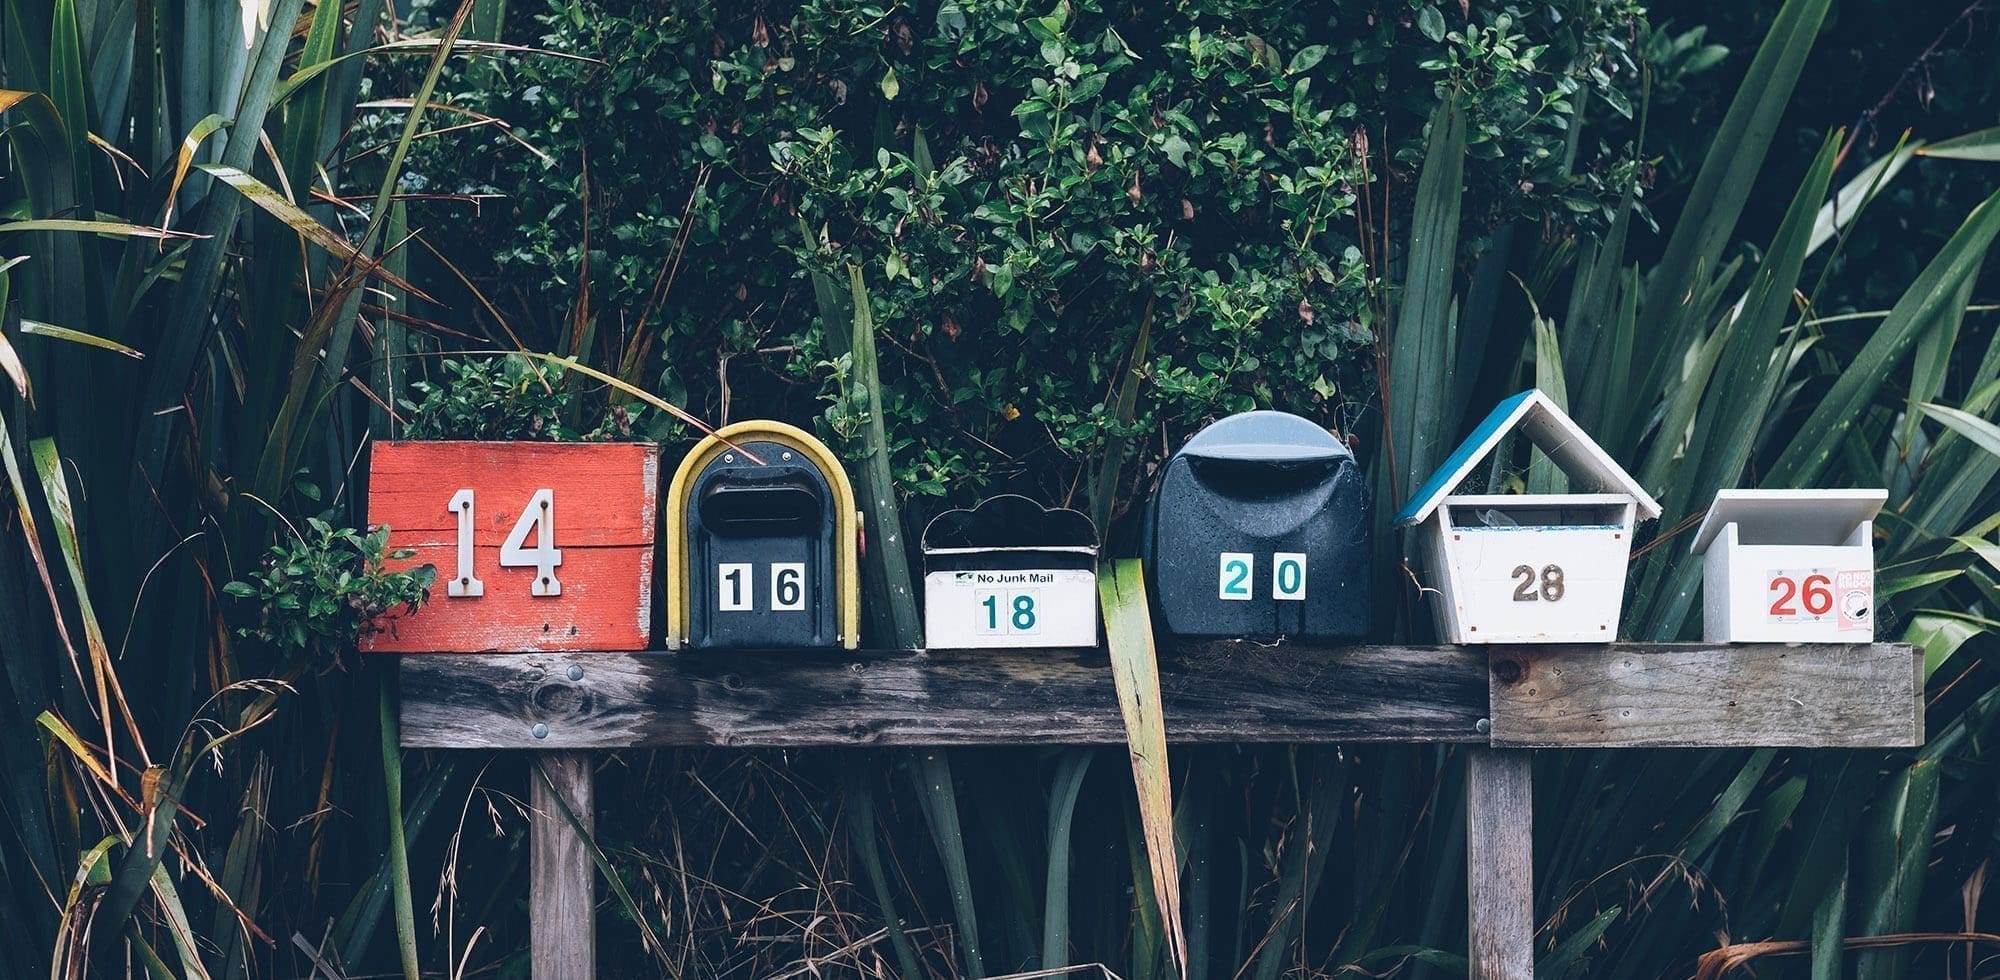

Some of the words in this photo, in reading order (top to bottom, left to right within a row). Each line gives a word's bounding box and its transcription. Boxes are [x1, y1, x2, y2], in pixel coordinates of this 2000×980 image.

[447, 488, 562, 597] 14
[725, 569, 800, 606] 16
[977, 573, 994, 583] No
[997, 573, 1026, 583] Junk
[1029, 573, 1054, 583] Mail
[1224, 559, 1302, 594] 20
[1511, 564, 1565, 602] 28
[1770, 574, 1833, 615] 26
[982, 595, 1036, 630] 18
